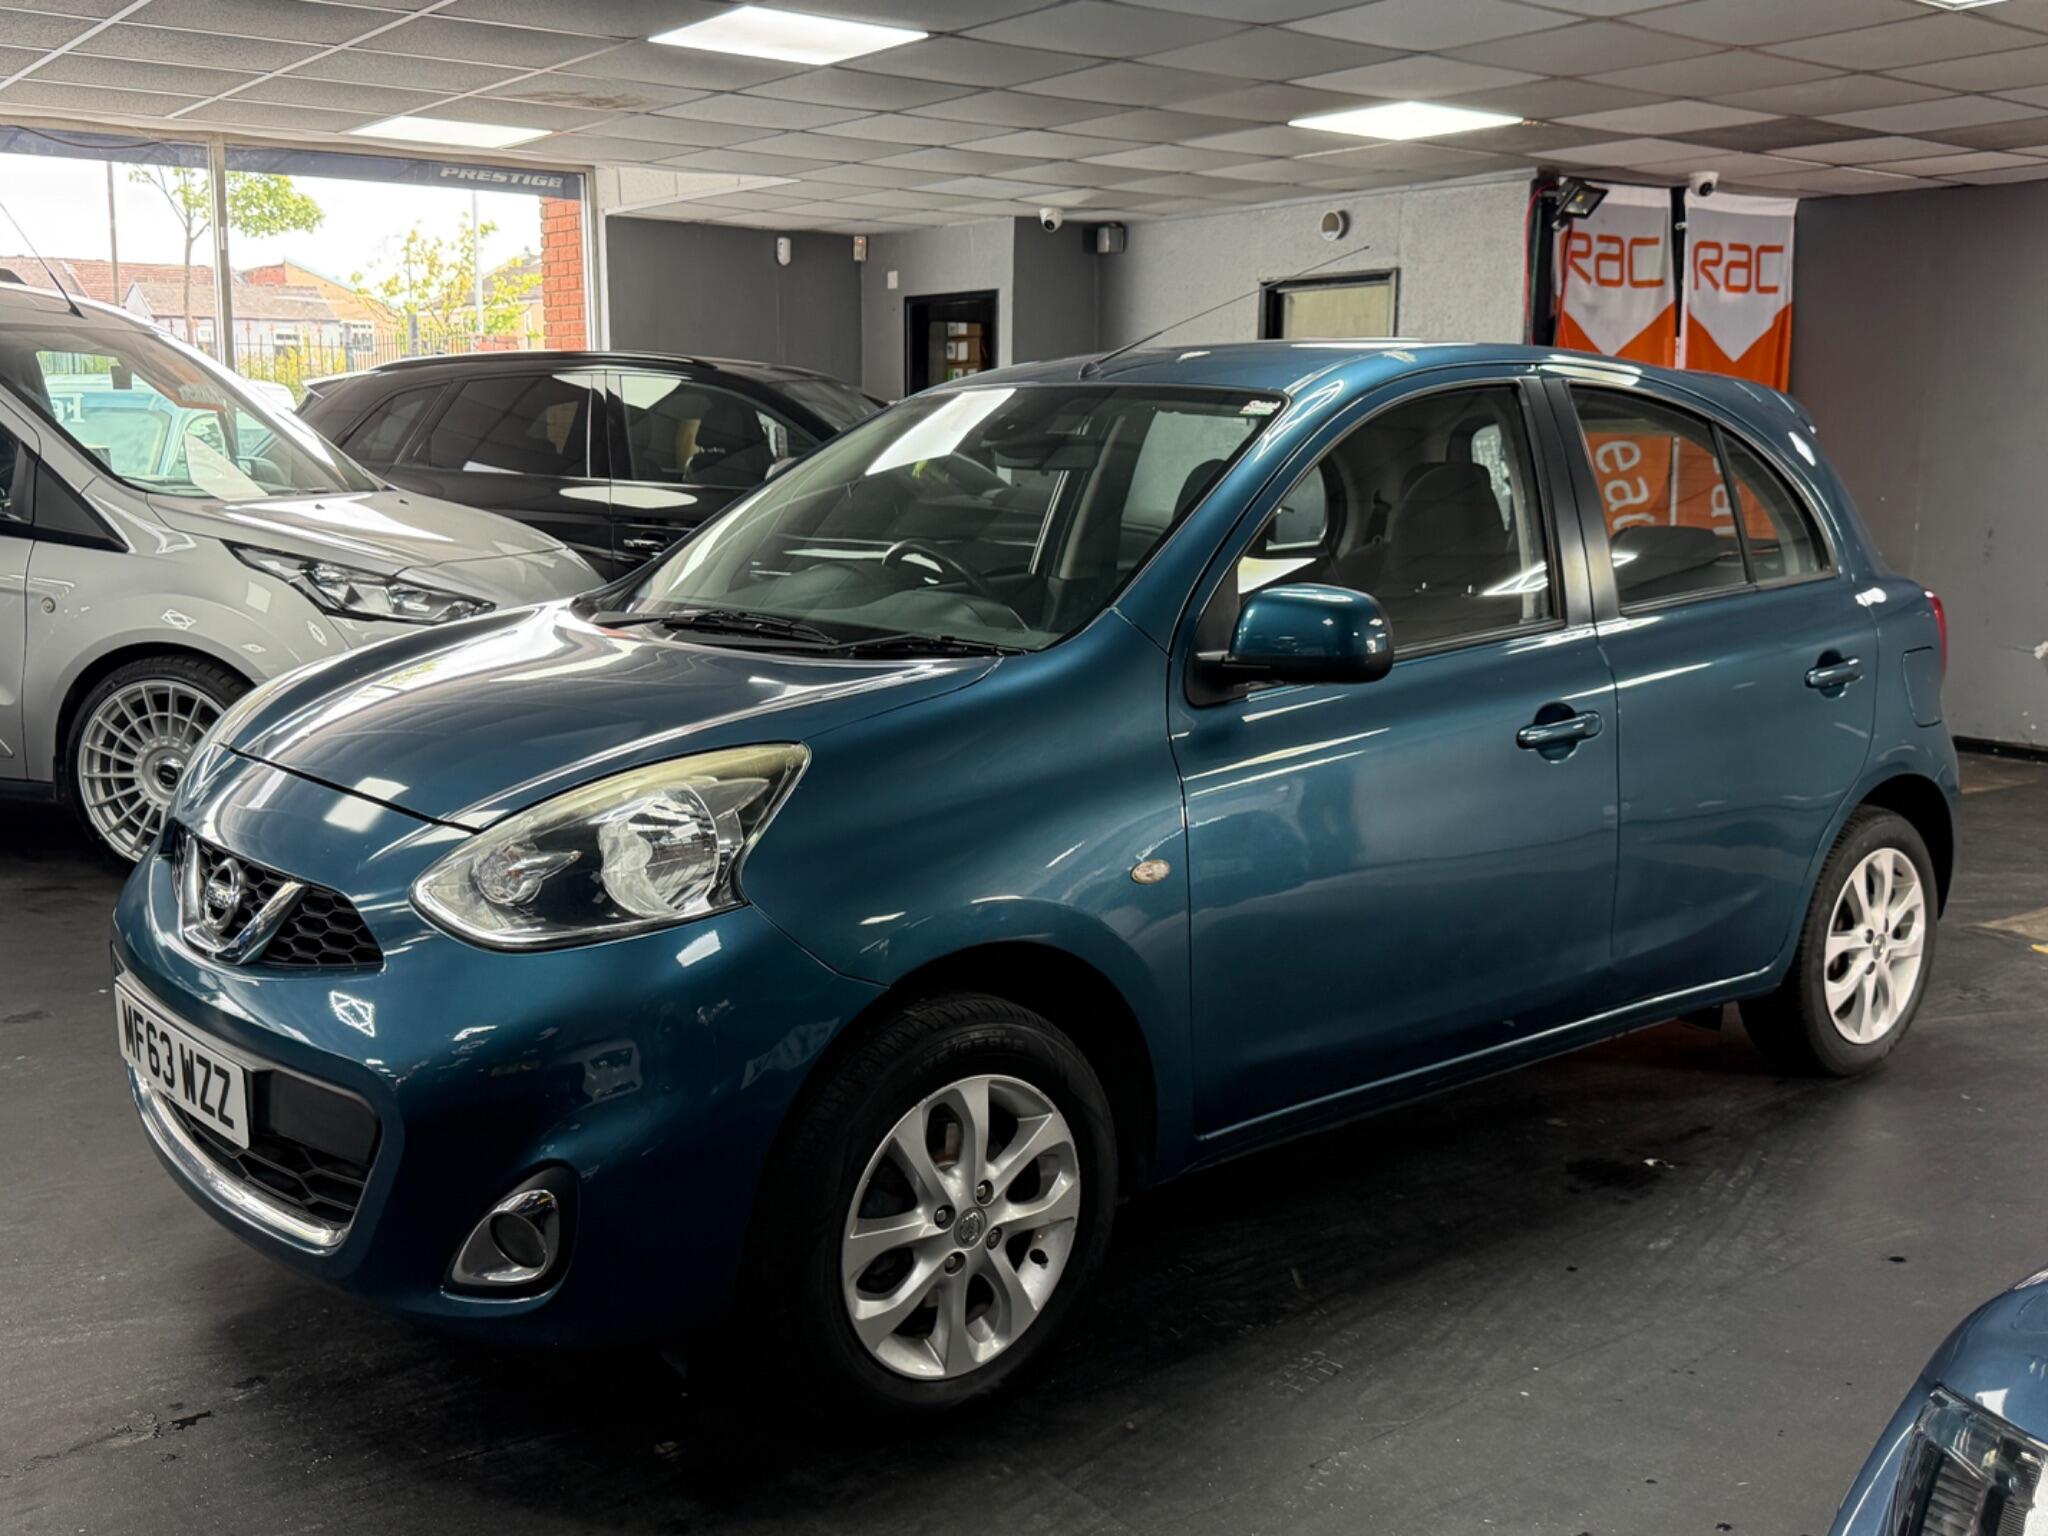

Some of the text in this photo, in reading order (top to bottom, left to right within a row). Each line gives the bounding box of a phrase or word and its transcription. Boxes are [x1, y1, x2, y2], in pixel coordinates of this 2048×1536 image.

[440, 167, 563, 188] PRESTIGE
[121, 998, 235, 1130] MF63 WZZ
